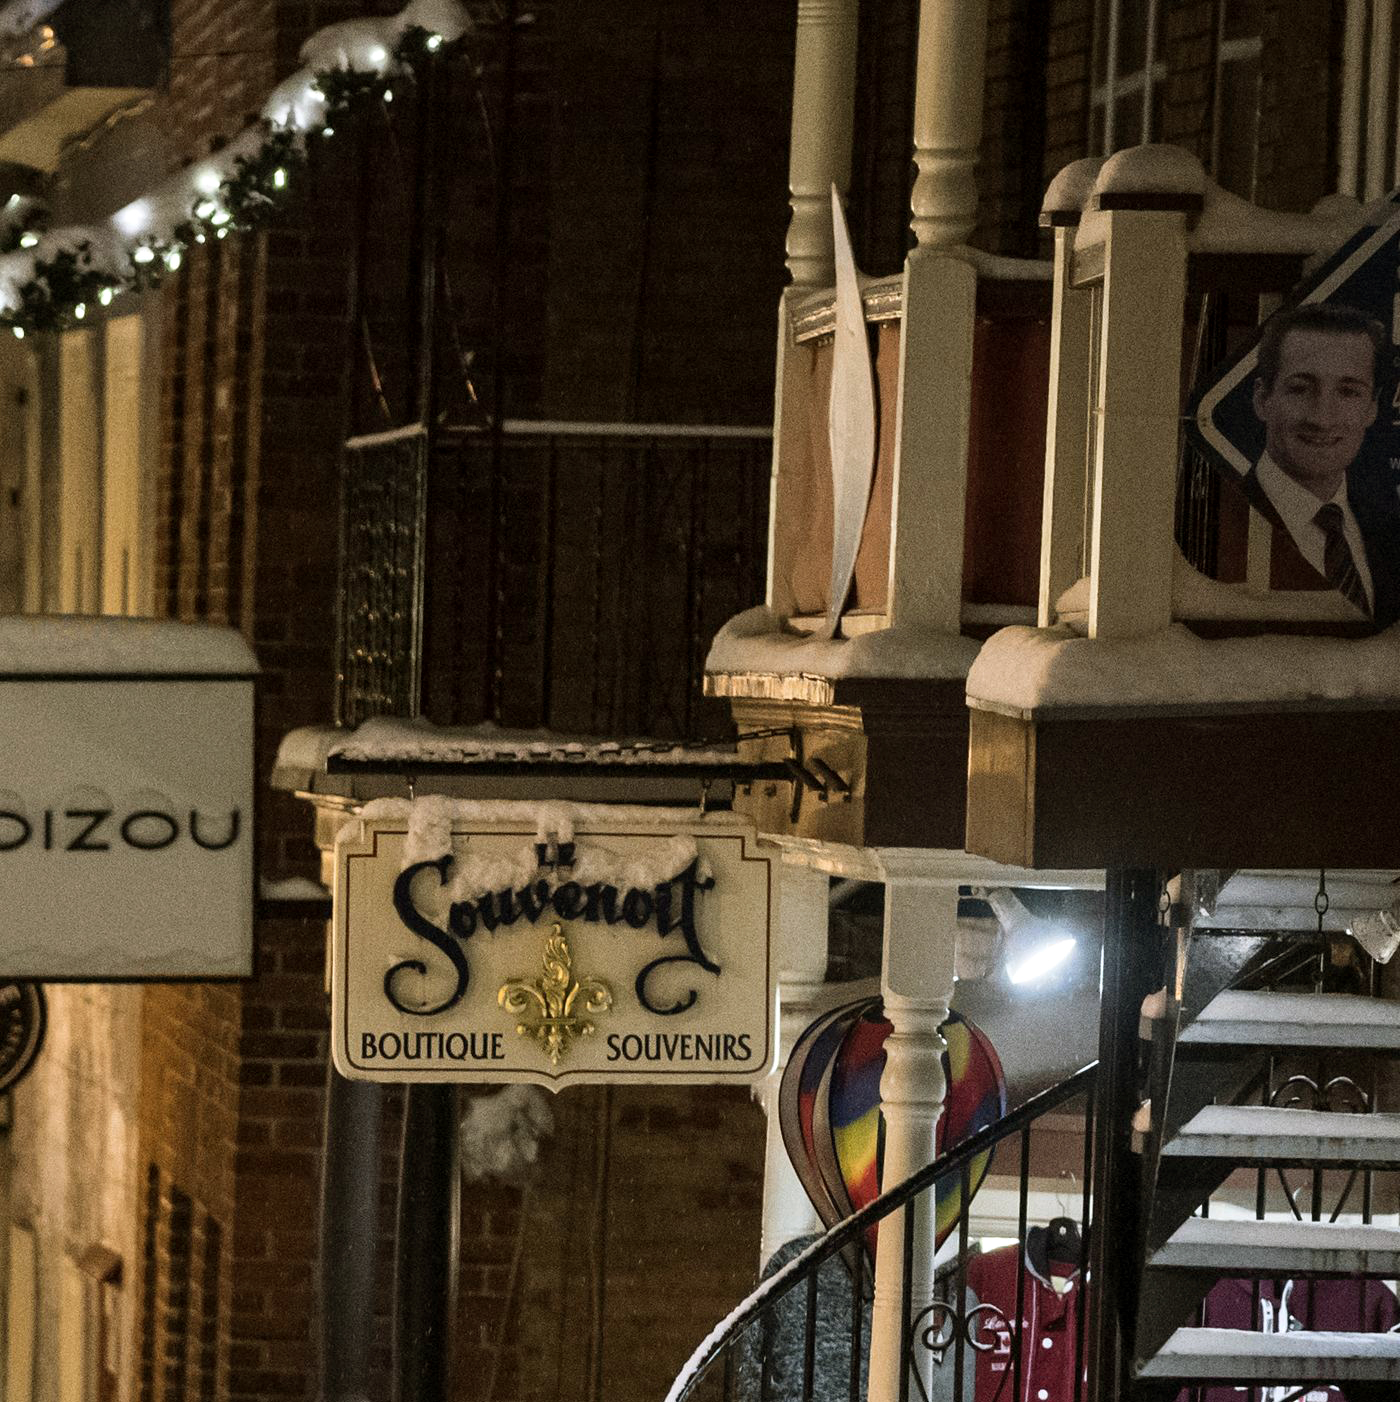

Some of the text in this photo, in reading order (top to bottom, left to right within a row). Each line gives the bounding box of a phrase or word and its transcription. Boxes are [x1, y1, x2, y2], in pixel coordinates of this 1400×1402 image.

[534, 838, 577, 867] LE
[360, 1031, 753, 1062] BOUTIQUE SOUVENIRS
